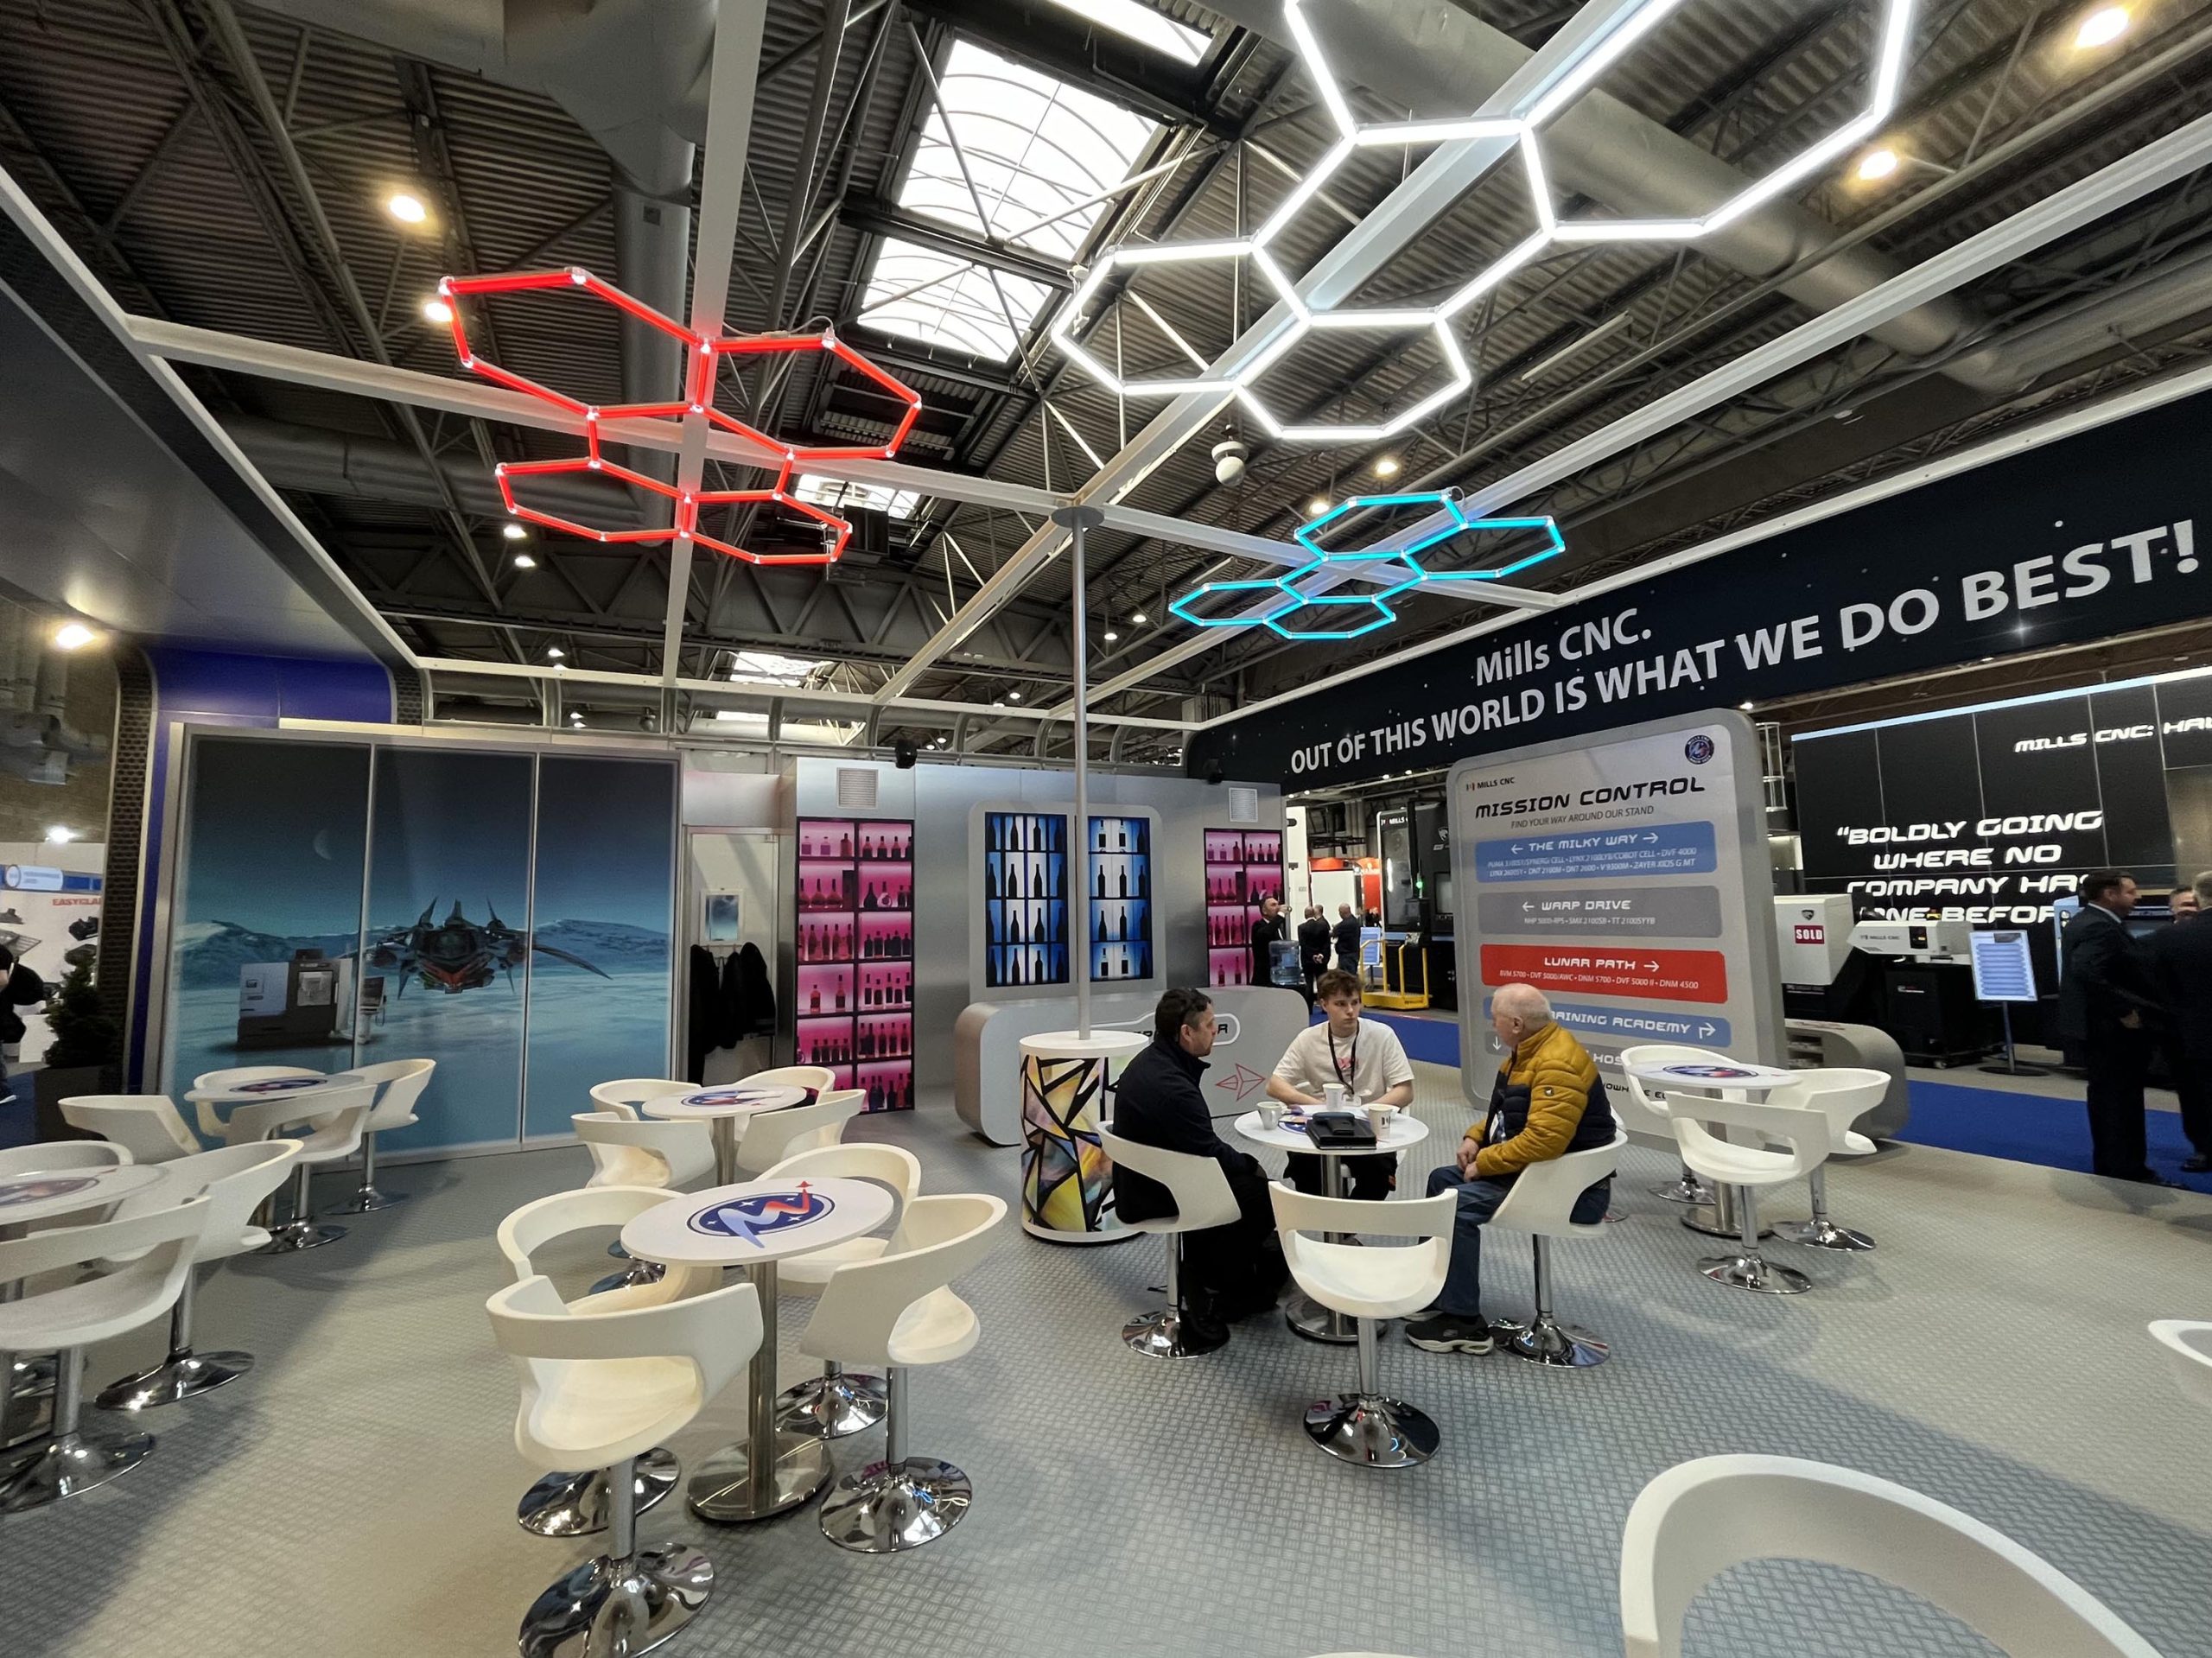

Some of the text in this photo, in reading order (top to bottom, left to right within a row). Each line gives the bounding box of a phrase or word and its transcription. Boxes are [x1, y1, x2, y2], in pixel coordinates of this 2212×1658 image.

[1291, 518, 2199, 774] OUT OF THIS WORLD IS WHAT WE DO BEST!
[1476, 607, 1652, 686] Mills CNC.
[2014, 733, 2088, 753] MILLS
[2094, 724, 2155, 743] CNC:
[1477, 777, 1516, 789] MILLS CNC
[1475, 777, 1706, 819] MISSION CONTROL
[1510, 805, 1655, 829] FIND YOUR WAY AROUND OUR STAND
[1976, 810, 2103, 837] GOING
[1529, 834, 1638, 852] THE MILKY WAY
[1873, 844, 2063, 870] WHERE NO
[1541, 900, 1631, 911] WARP DRIVE
[1796, 929, 1823, 940] SOLD
[1544, 957, 1636, 970] LUNAR PATH
[1529, 971, 1541, 980] DVF
[1578, 974, 1594, 982] DNM
[1595, 975, 1611, 984] 5700
[1616, 976, 1630, 985] DVF
[1631, 977, 1649, 986] 5000
[1659, 979, 1678, 988] DNM
[1679, 980, 1699, 989] 4500
[1551, 1011, 1691, 1034] RAINING ACADEMY
